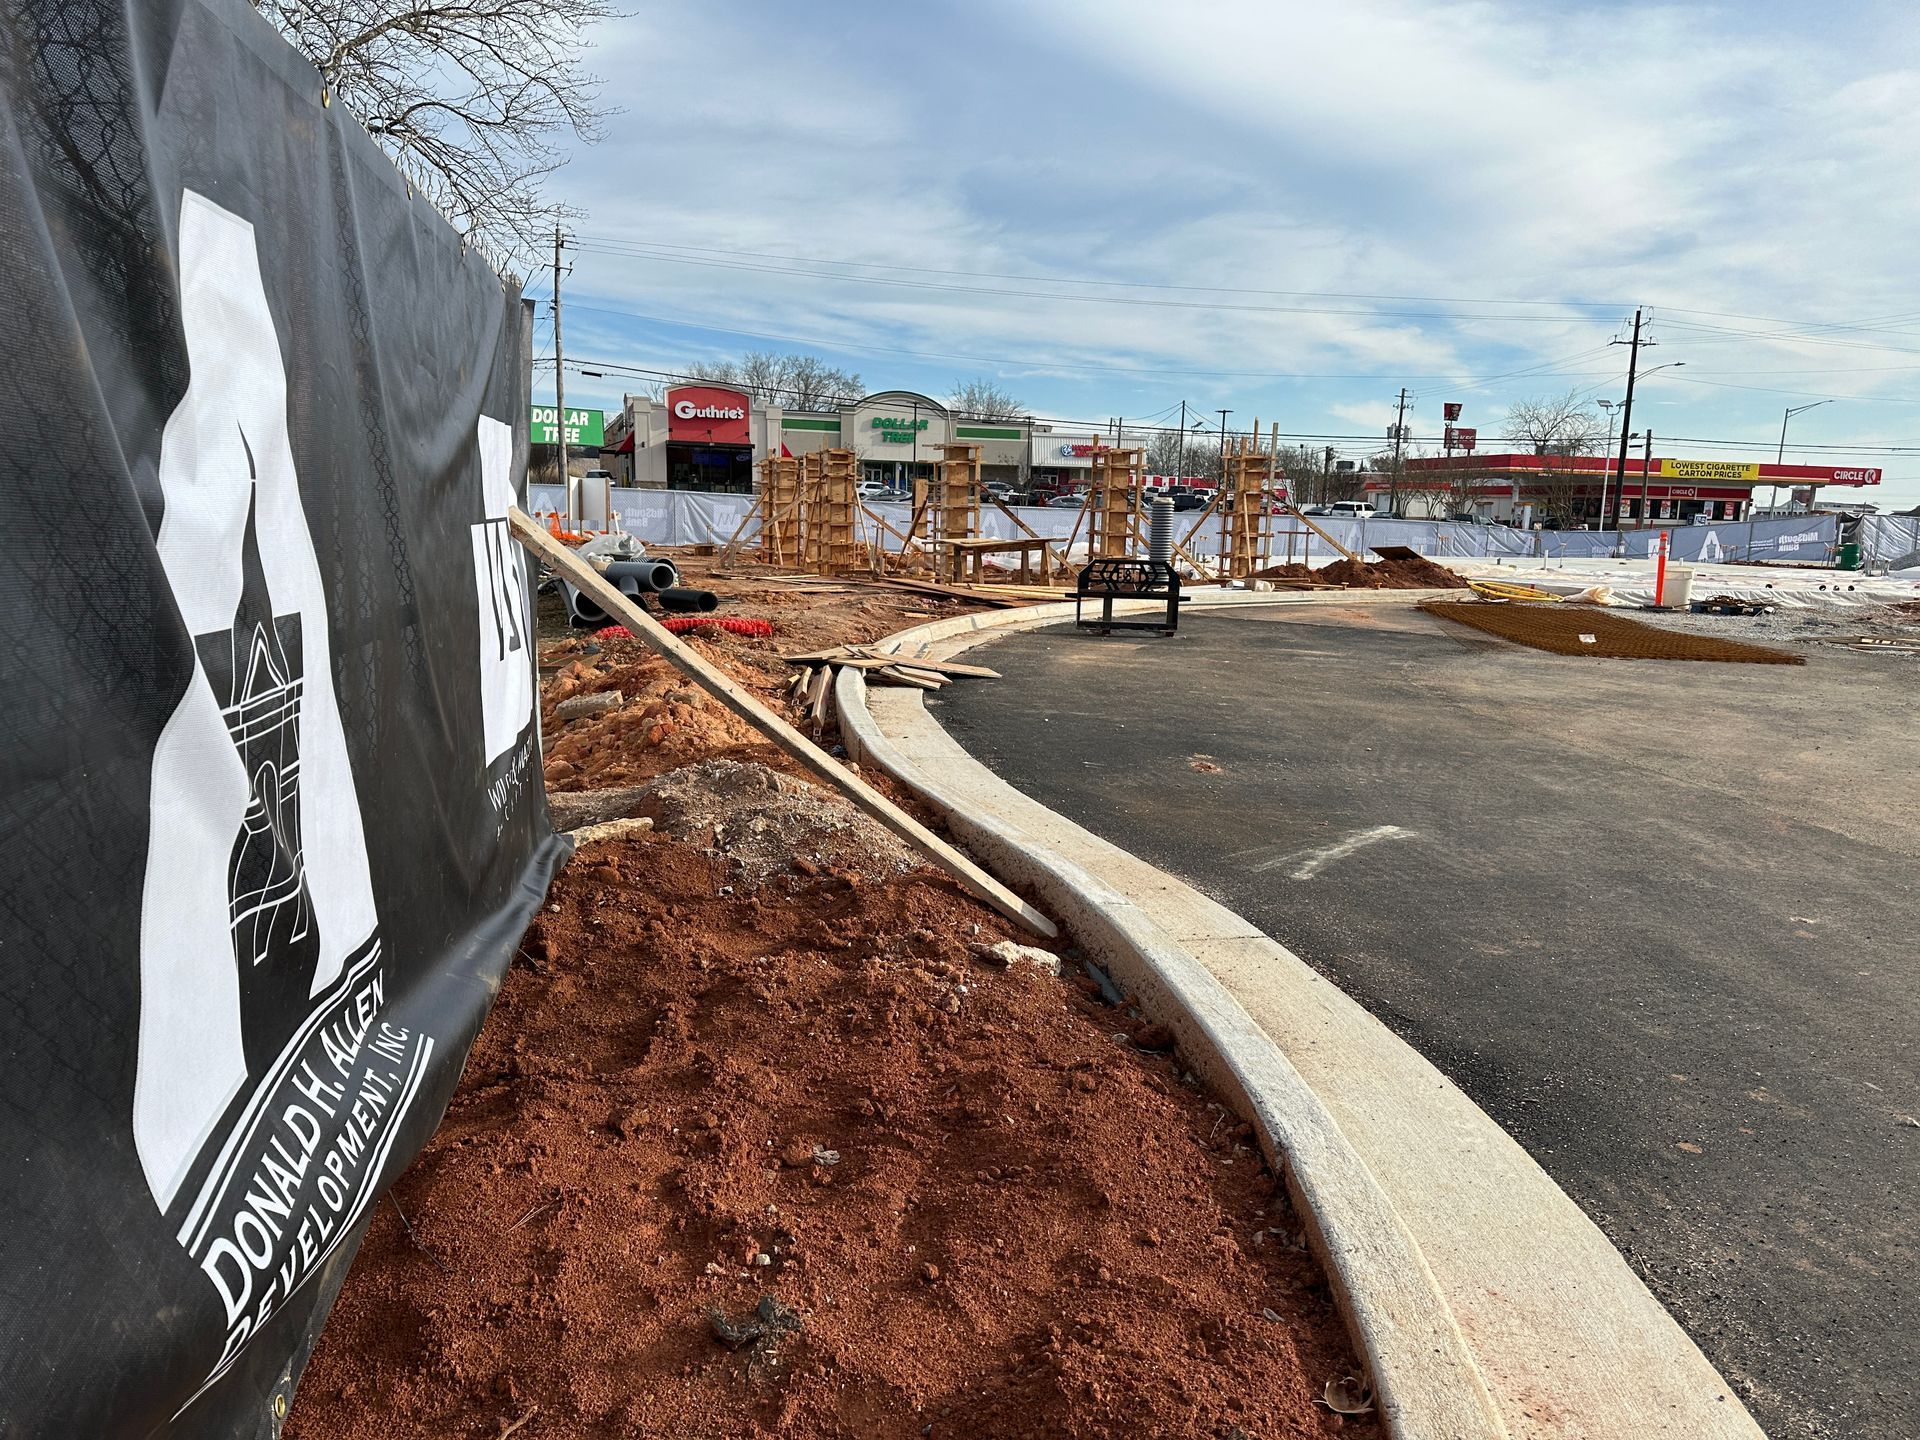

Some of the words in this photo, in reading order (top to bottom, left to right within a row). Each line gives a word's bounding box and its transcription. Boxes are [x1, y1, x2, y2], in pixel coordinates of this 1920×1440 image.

[675, 400, 744, 419] Guthrie's
[872, 417, 929, 431] DOLLAR
[543, 426, 580, 443] TREE
[882, 431, 916, 443] TREE
[1671, 461, 1704, 471] LOWEST
[1706, 463, 1751, 472] CIGARETTE
[1679, 469, 1712, 478] CARTON
[1714, 470, 1742, 479] PRICES
[1834, 470, 1863, 481] CIRCLE
[1864, 469, 1876, 484] K
[201, 1104, 322, 1330] DONALD
[292, 1057, 345, 1119] H.
[319, 969, 386, 1076] ALLEN
[206, 1068, 402, 1380] DEVELOPMENT,
[367, 1022, 411, 1060] INC.
